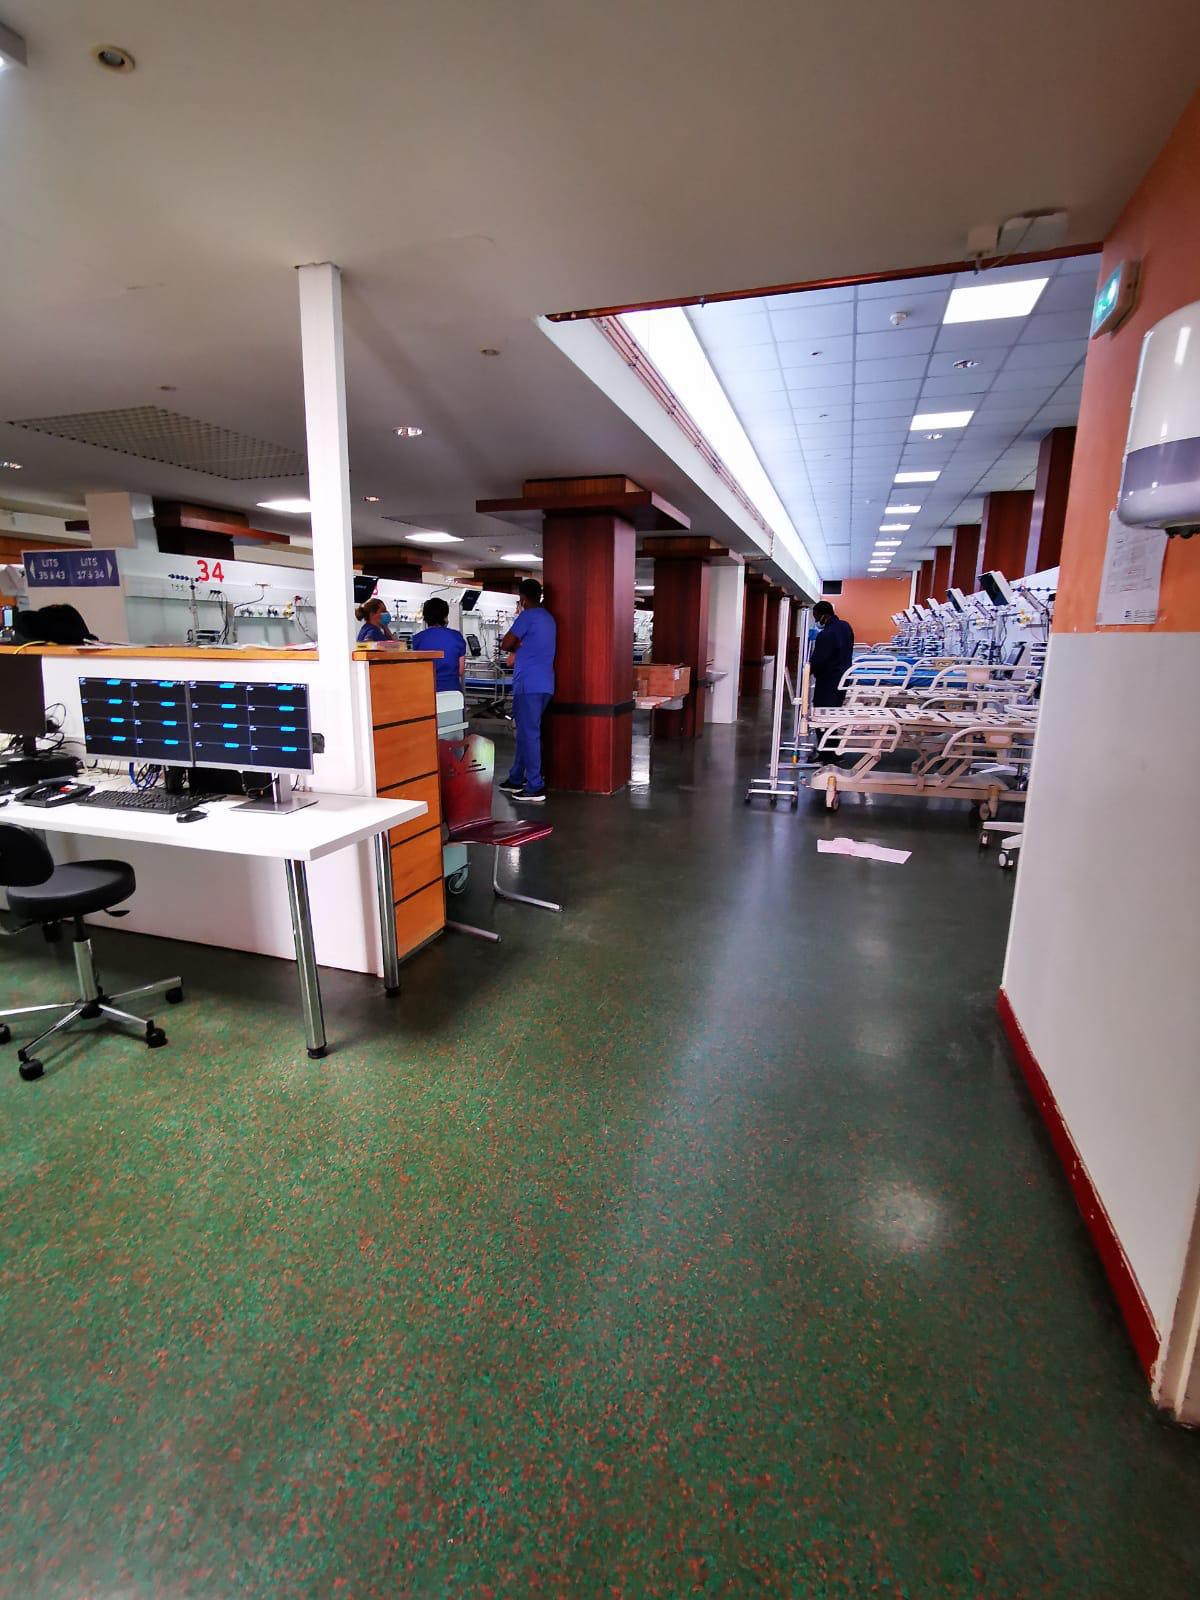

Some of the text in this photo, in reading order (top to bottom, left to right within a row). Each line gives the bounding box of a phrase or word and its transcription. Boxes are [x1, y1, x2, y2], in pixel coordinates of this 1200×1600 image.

[42, 558, 59, 568] LITS
[80, 557, 98, 567] LITS
[196, 559, 225, 583] 34
